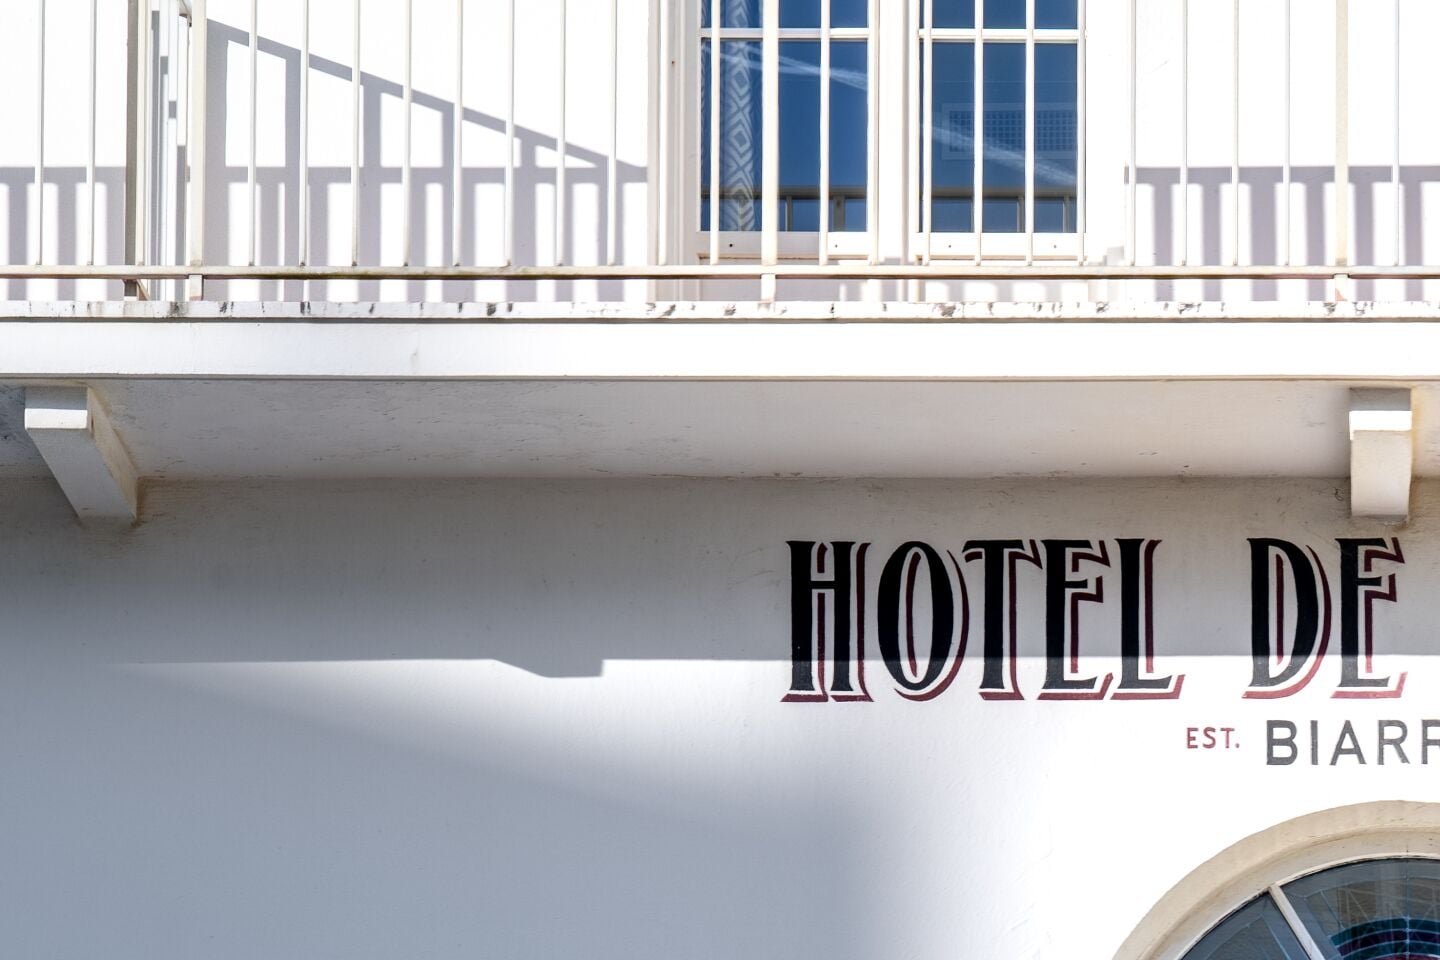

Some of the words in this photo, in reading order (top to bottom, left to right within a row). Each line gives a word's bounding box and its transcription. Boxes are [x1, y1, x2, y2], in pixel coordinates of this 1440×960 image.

[780, 537, 1185, 702] HOTEL
[1242, 537, 1406, 699] DE
[1186, 727, 1240, 749] EST.
